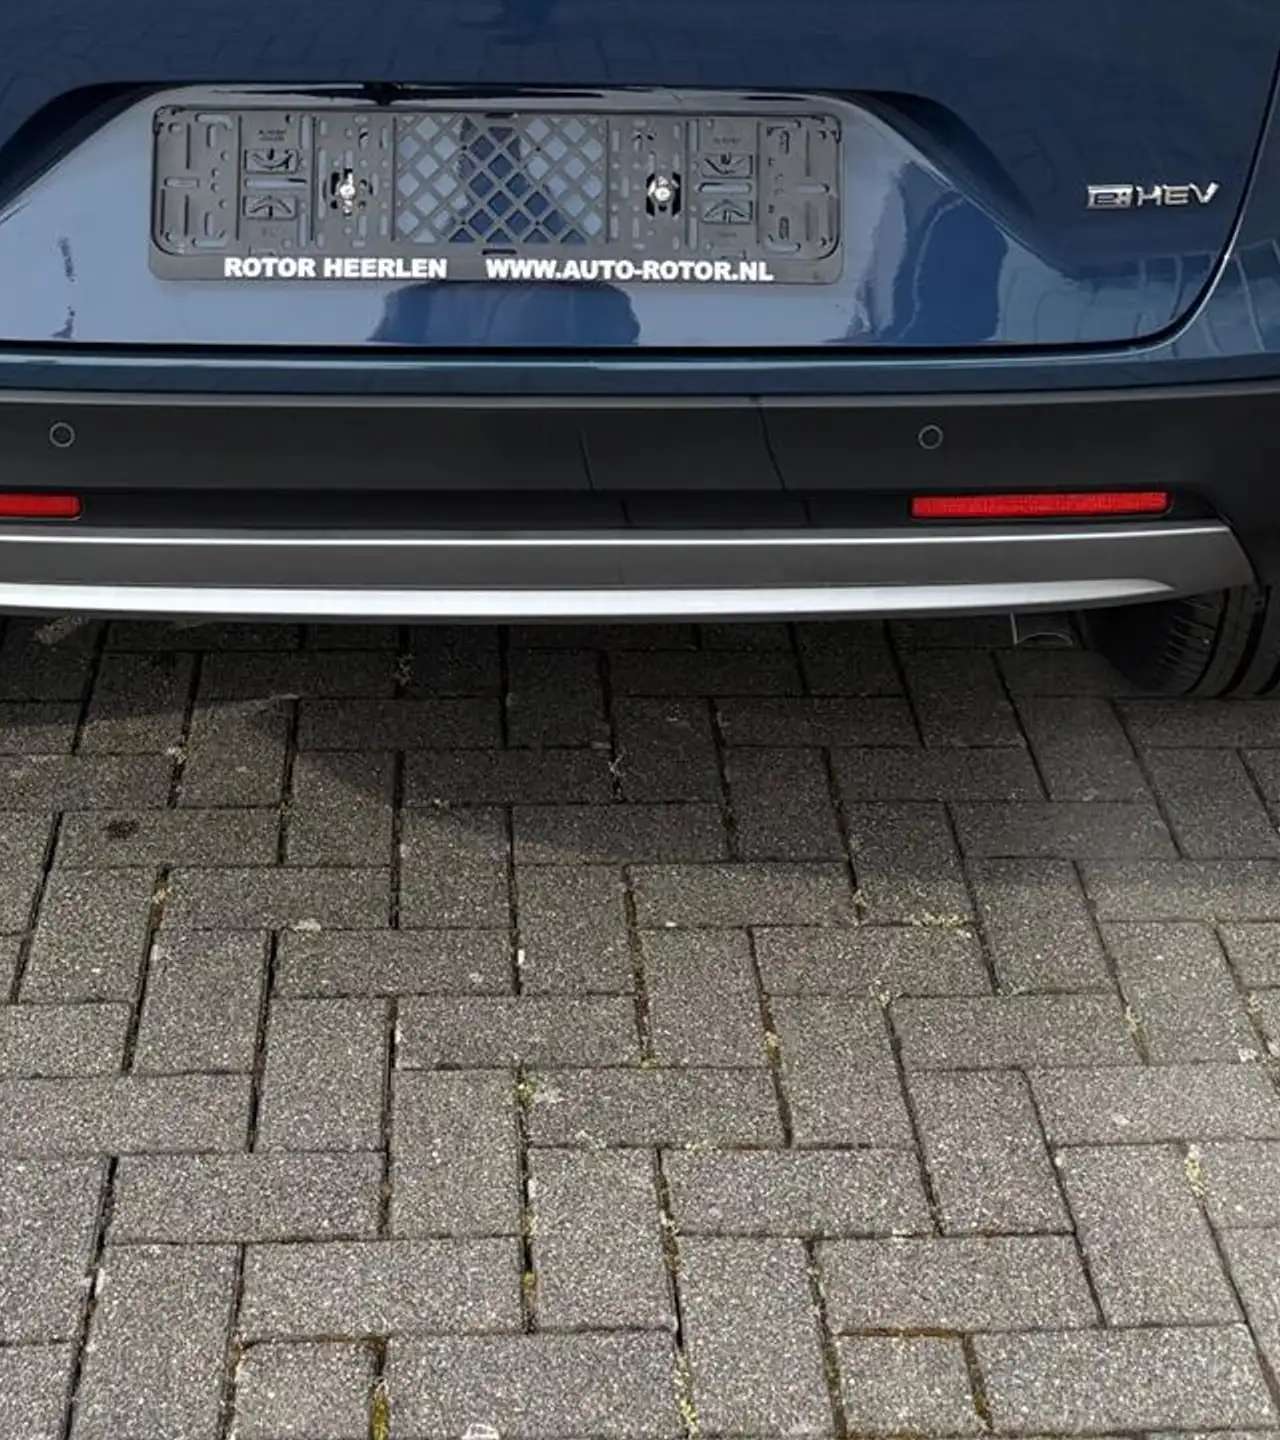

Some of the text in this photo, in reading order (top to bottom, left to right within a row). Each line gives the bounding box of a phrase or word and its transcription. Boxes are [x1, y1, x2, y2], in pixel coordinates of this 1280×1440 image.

[224, 258, 774, 281] ROTOR HEERLEN WWW.AUTO-ROTOR.NL
